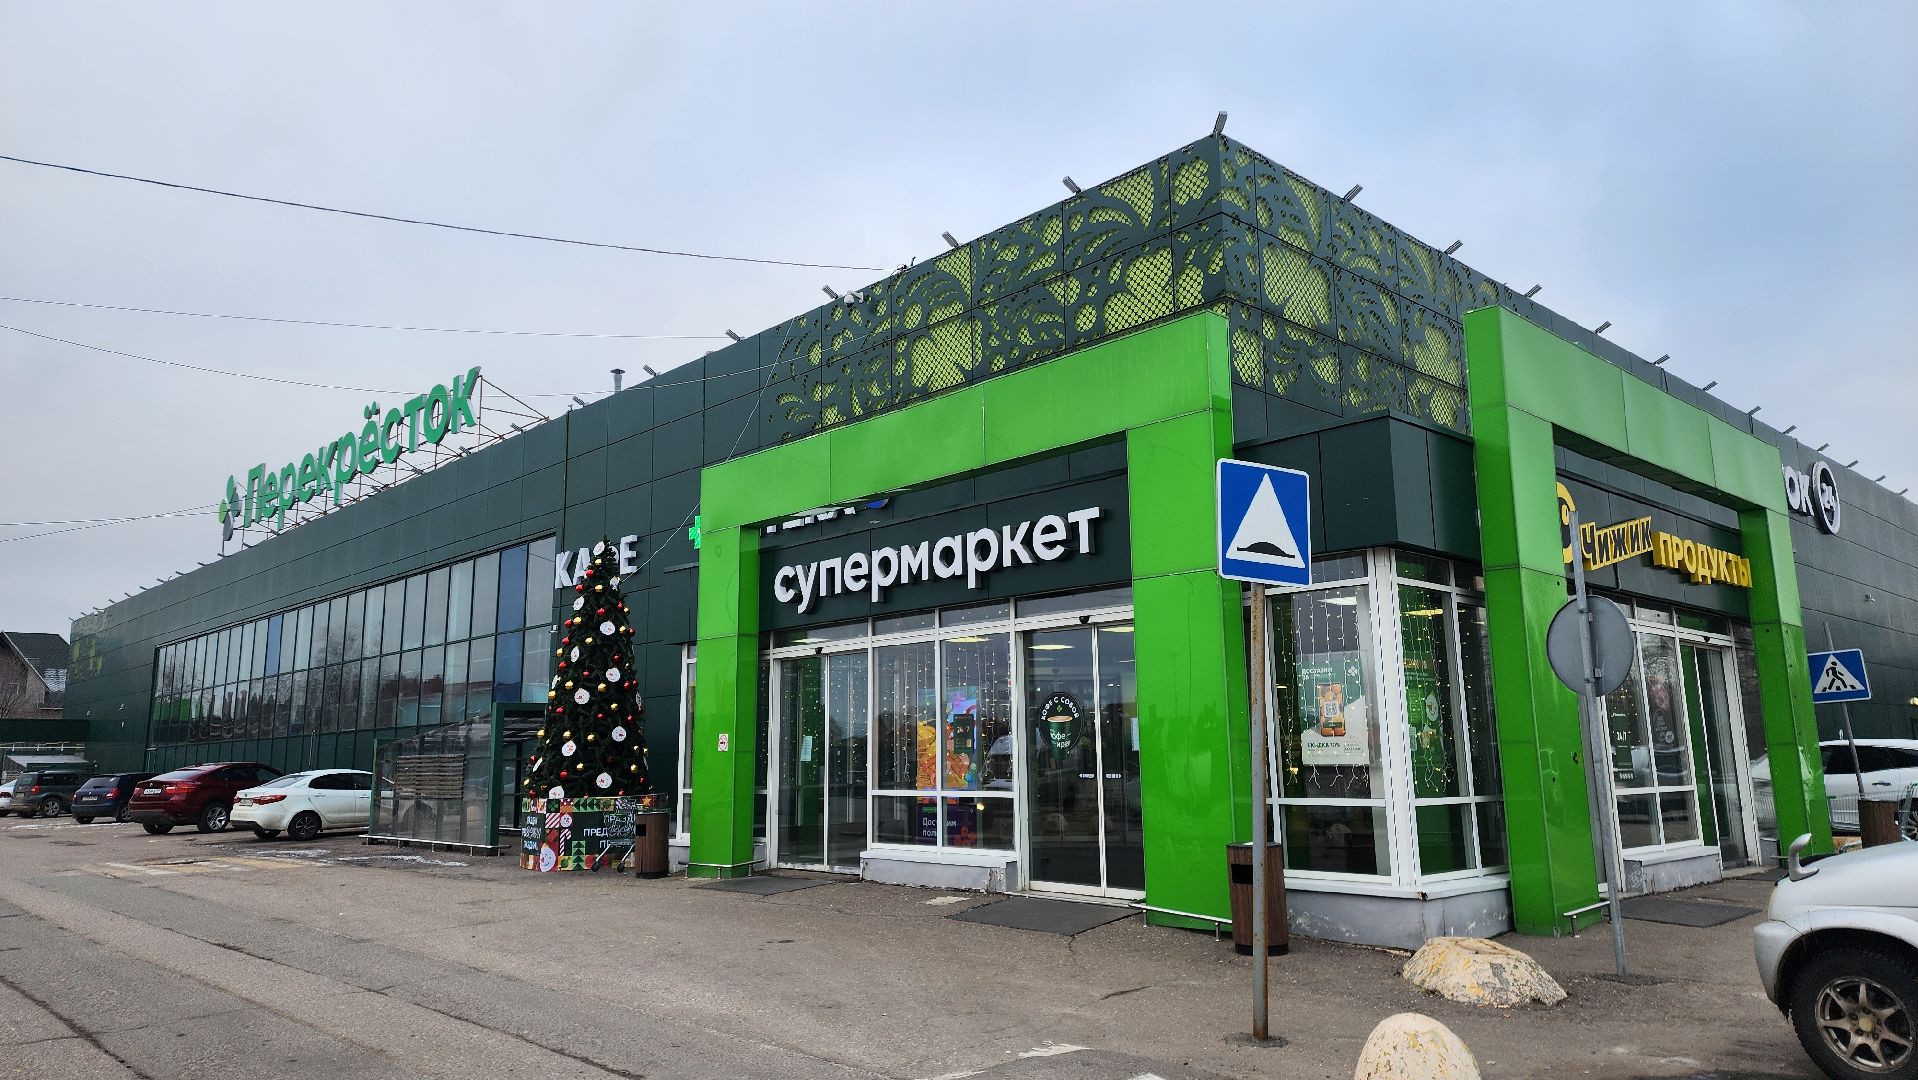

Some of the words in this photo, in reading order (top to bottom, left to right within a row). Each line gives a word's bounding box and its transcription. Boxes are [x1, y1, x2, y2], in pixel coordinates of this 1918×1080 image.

[244, 366, 481, 531] Перекрёсток
[555, 534, 638, 589] КАЕ
[773, 506, 1104, 614] супермаркет
[1653, 531, 1753, 588] ПРОДУКТЫ
